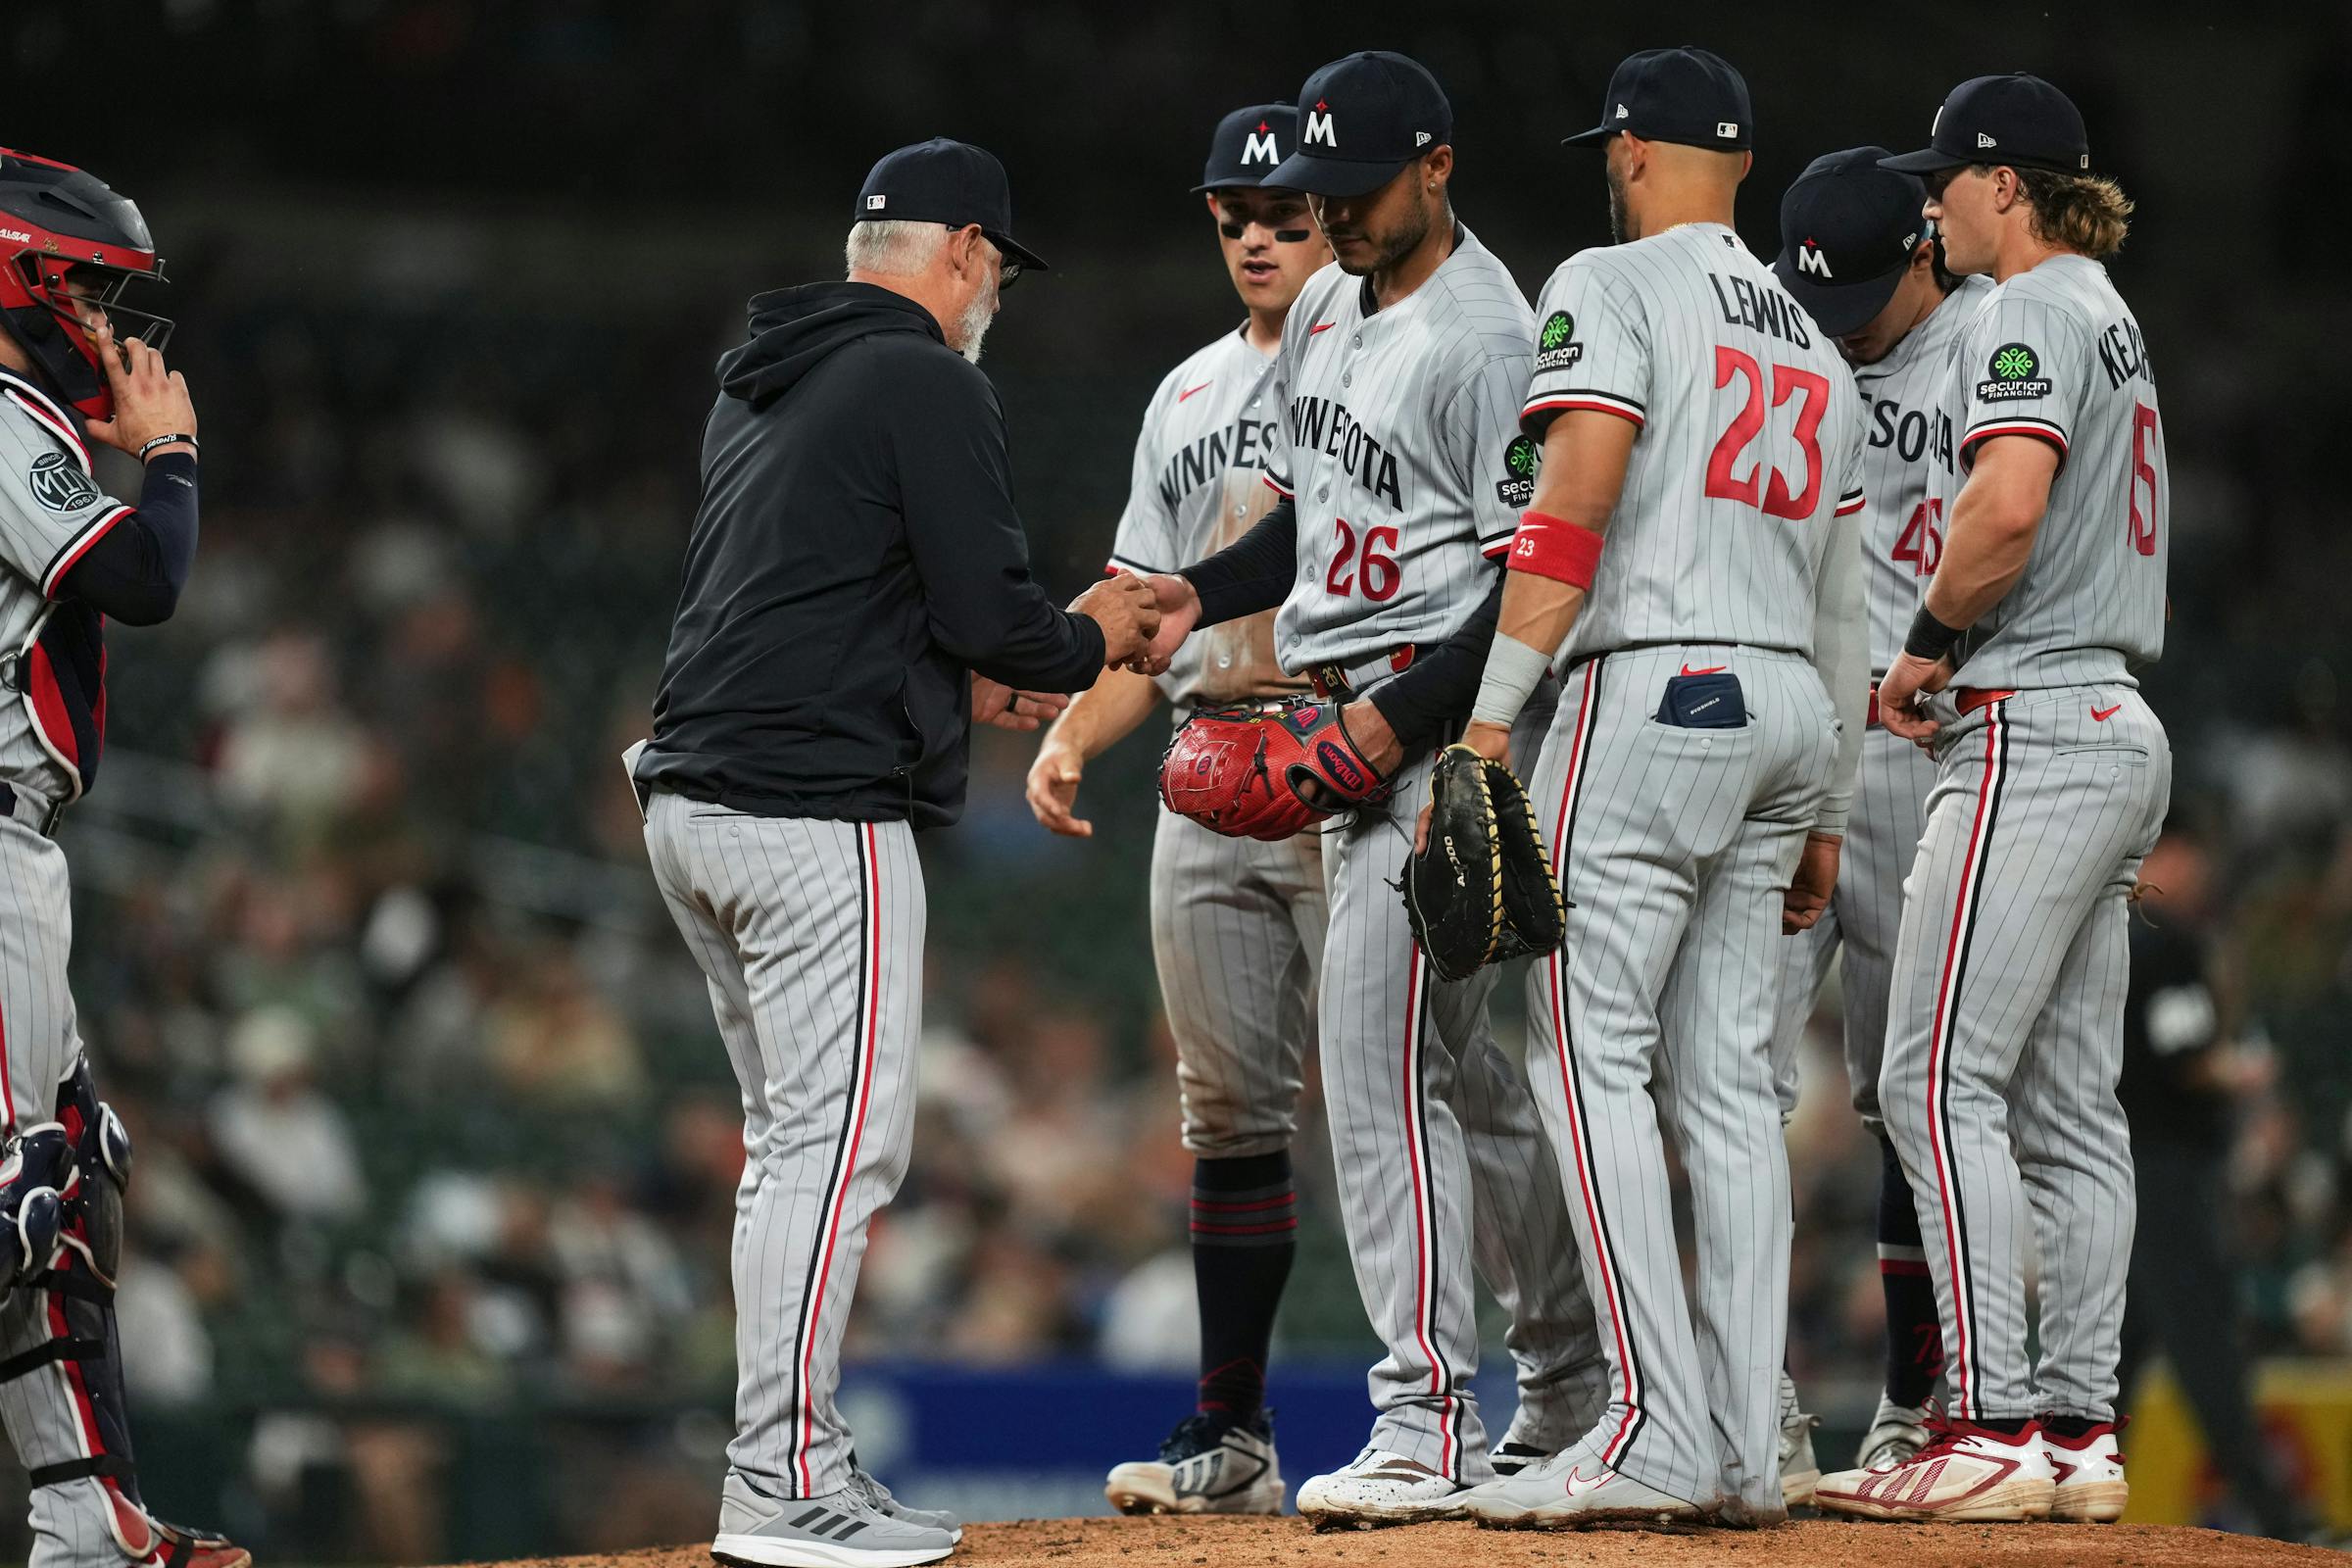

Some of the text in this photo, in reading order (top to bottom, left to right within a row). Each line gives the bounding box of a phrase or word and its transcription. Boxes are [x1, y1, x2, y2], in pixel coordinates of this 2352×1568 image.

[1303, 111, 1338, 148] M
[1240, 132, 1280, 166] M
[1797, 245, 1834, 278] M
[1708, 272, 1811, 350] LEWIS
[1980, 380, 2048, 395] securian
[1987, 390, 2038, 400] FINANCIAL
[1704, 344, 1830, 520] 23
[37, 453, 62, 466] SINCE
[71, 495, 94, 510] 1961
[1326, 517, 1401, 602] 26
[1516, 537, 1536, 558] 23
[1320, 744, 1362, 791] Wilson
